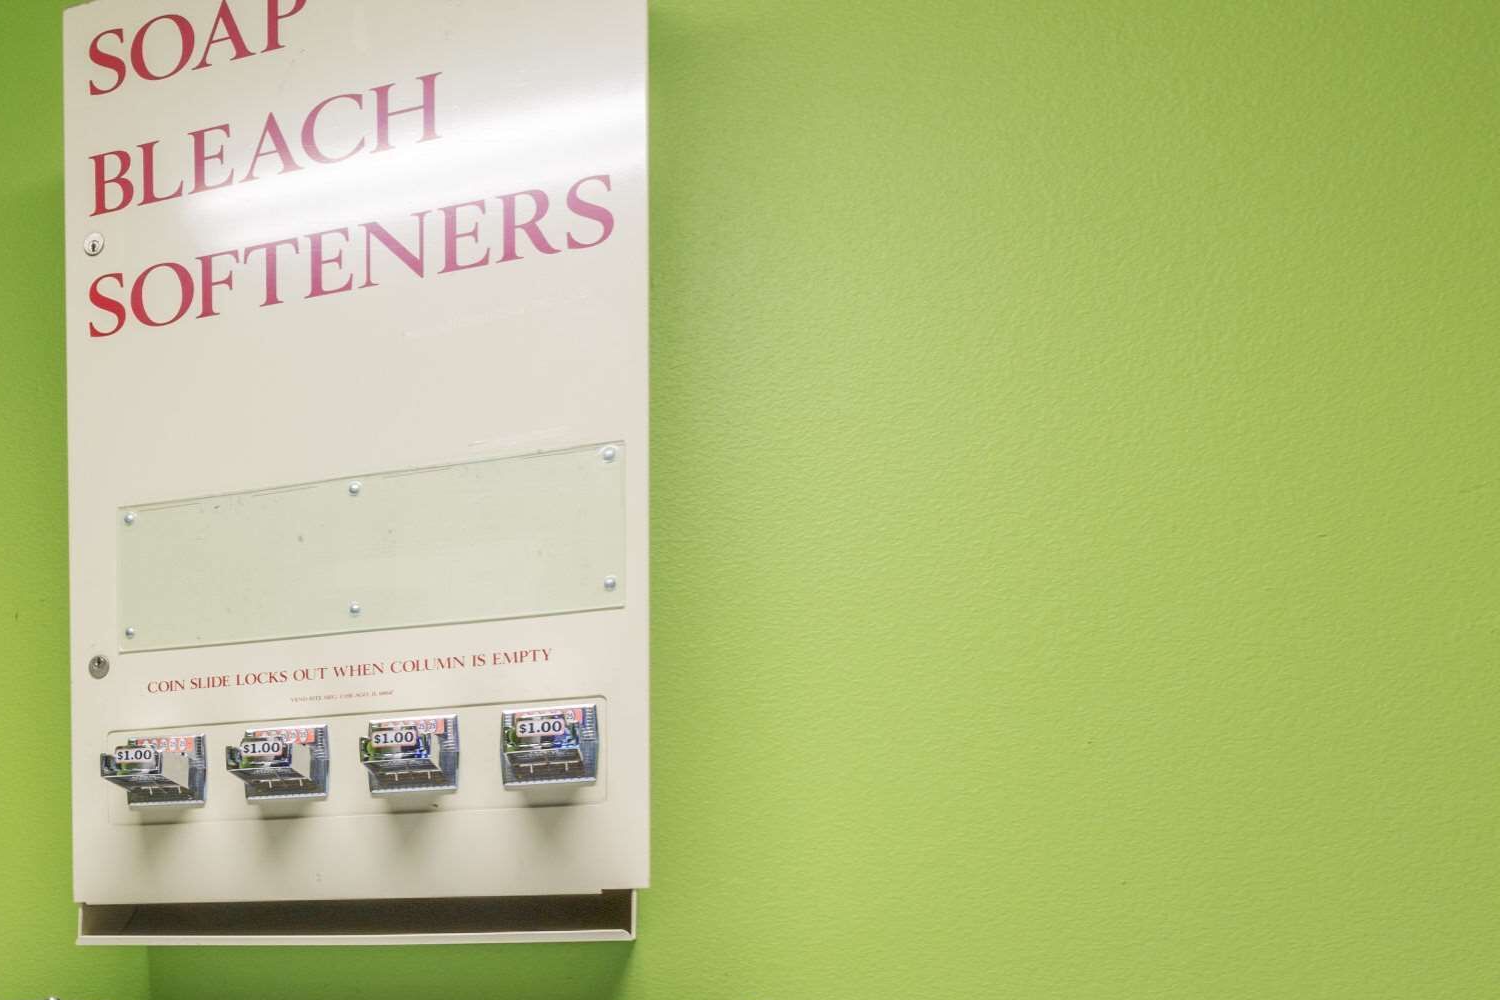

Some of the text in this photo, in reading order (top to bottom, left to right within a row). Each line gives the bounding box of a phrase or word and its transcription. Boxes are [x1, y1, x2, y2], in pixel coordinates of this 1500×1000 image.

[88, 0, 305, 96] SOAP
[88, 72, 443, 217] BLEACH
[87, 174, 616, 338] SOFTENERS
[147, 647, 552, 694] COIN SLIDE LOCKS OUT WHEN COLUMN IS EMPTY
[374, 731, 414, 744] $1.00
[519, 720, 562, 734] $1.00
[117, 749, 152, 761] $1.00
[243, 742, 280, 754] $1.00
